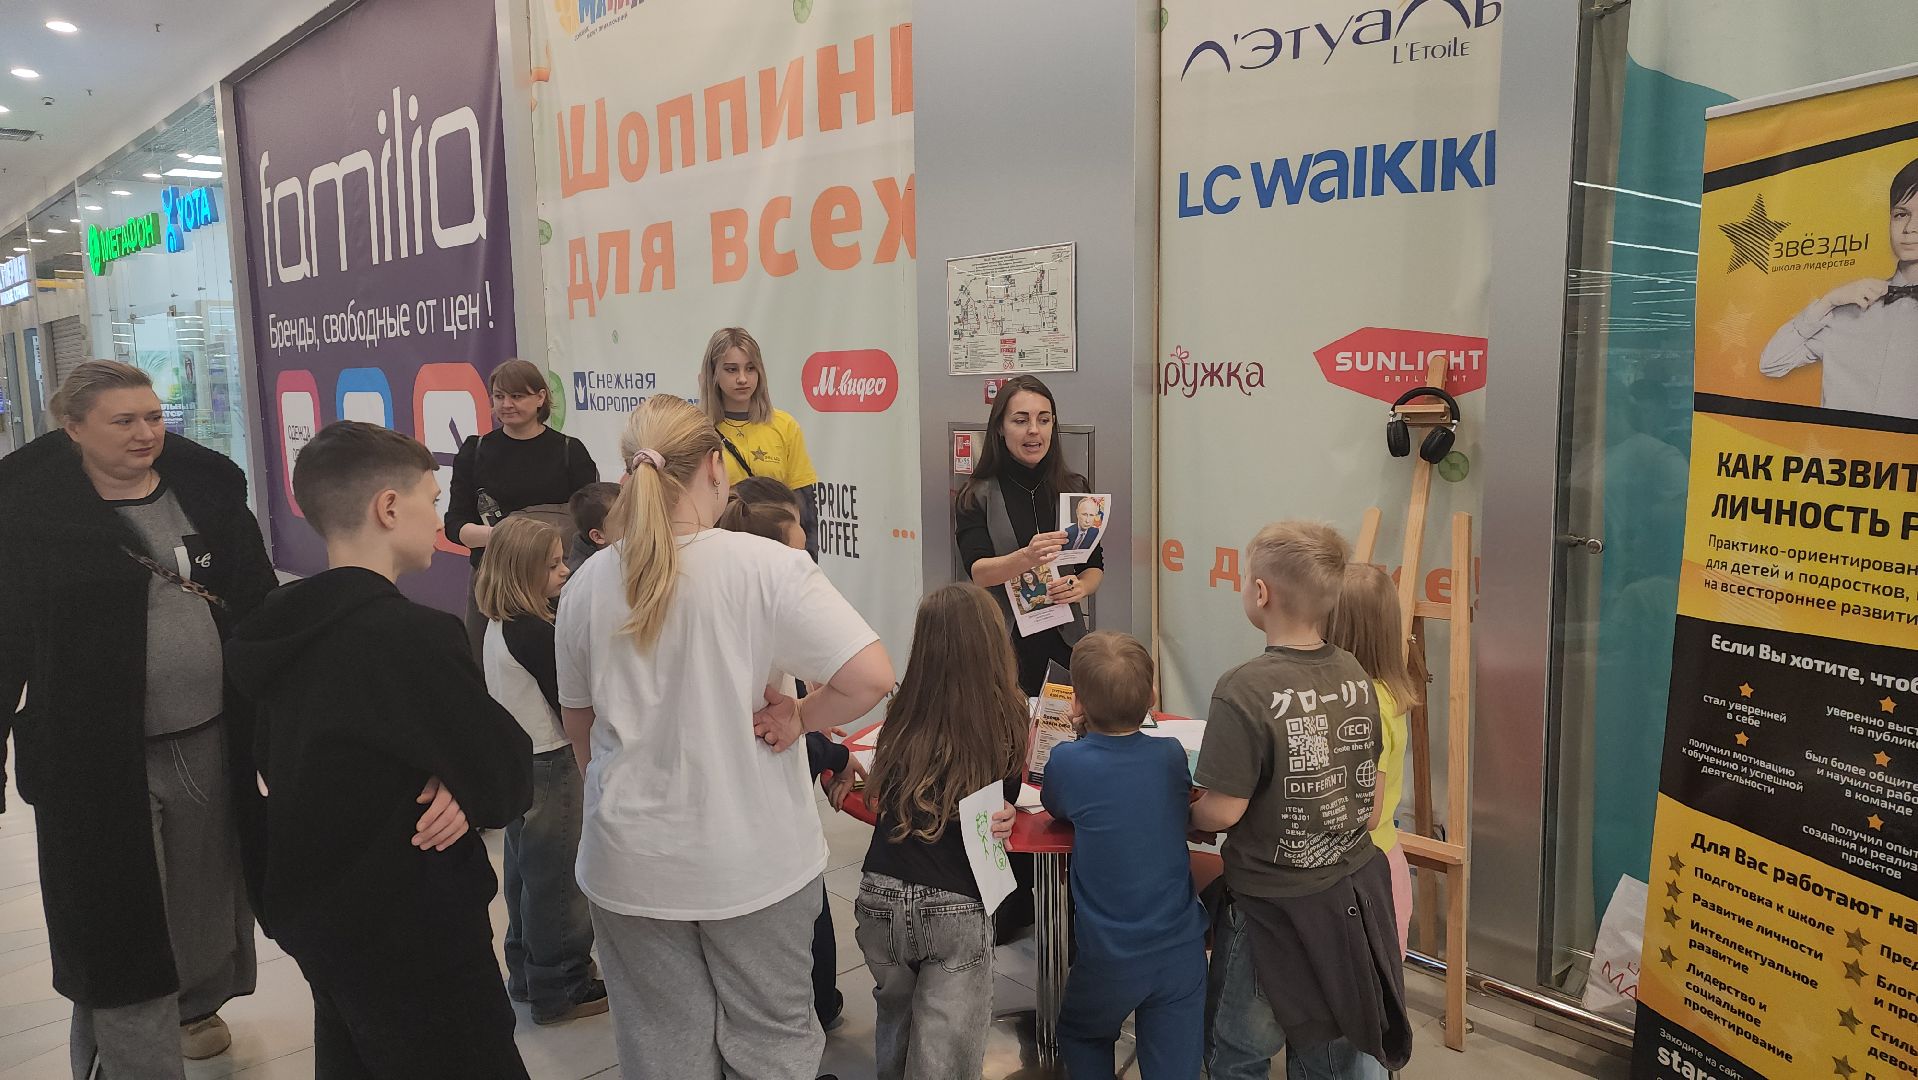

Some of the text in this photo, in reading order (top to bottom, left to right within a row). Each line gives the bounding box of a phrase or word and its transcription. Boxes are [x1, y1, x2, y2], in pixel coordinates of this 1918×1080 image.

[259, 86, 487, 288] familia
[1178, 164, 1242, 219] LC
[176, 187, 214, 233] YOTA
[567, 173, 917, 320] для всех
[1771, 258, 1856, 273] школа лидерства
[1772, 232, 1869, 259] звёзды
[269, 312, 320, 357] Бренды,
[322, 299, 411, 348] свободные
[416, 300, 437, 335] от
[587, 370, 656, 390] Снежная
[1158, 358, 1266, 398] ружка
[1384, 375, 1467, 383] BRILLNT
[1716, 452, 1918, 493] КАК РАЗВИТ
[817, 481, 858, 521] PRICE
[1711, 493, 1890, 538] ЛИЧНОСТЬ
[818, 518, 860, 559] OFFEE
[1708, 534, 1918, 577] Практико-ориентирован
[1705, 558, 1910, 602] для детей и подростков,
[1704, 578, 1918, 626] на всестороннее развити
[1711, 633, 1755, 658] Если
[1758, 643, 1787, 664] Вы
[1789, 654, 1865, 686] хотите,
[1703, 694, 1788, 724] стал уверенней
[1726, 713, 1761, 728] в себе
[1825, 705, 1885, 728] уверенно
[1343, 723, 1370, 737] TECH
[1849, 725, 1865, 736] на
[1688, 738, 1796, 777] получил мотивацию
[1688, 749, 1739, 771] обучению
[1741, 765, 1748, 774] и
[1749, 767, 1804, 793] успешной
[1805, 749, 1829, 765] был
[1831, 757, 1866, 777] более
[1701, 765, 1775, 795] деятельности
[1816, 768, 1824, 776] и
[1826, 770, 1884, 795] научился
[1845, 789, 1913, 816] в команде
[1802, 825, 1857, 851] создания
[1860, 845, 1868, 856] и
[1831, 822, 1918, 859] получил опыт
[1690, 832, 1731, 860] Для
[1734, 848, 1768, 876] Вас
[1773, 865, 1883, 920] работают
[1841, 851, 1902, 880] проектов
[1694, 867, 1836, 936] Подготовка к школе
[1692, 892, 1824, 962] Развитие личности
[1688, 938, 1750, 975] развитие
[1689, 919, 1819, 990] Интеллектуальное
[1685, 980, 1762, 1028] социальное
[1686, 962, 1767, 1013] Лидерство и
[1873, 997, 1884, 1009] и
[1659, 1027, 1704, 1059] Заходите
[1705, 1055, 1717, 1068] на
[1683, 996, 1794, 1064] проектирование
